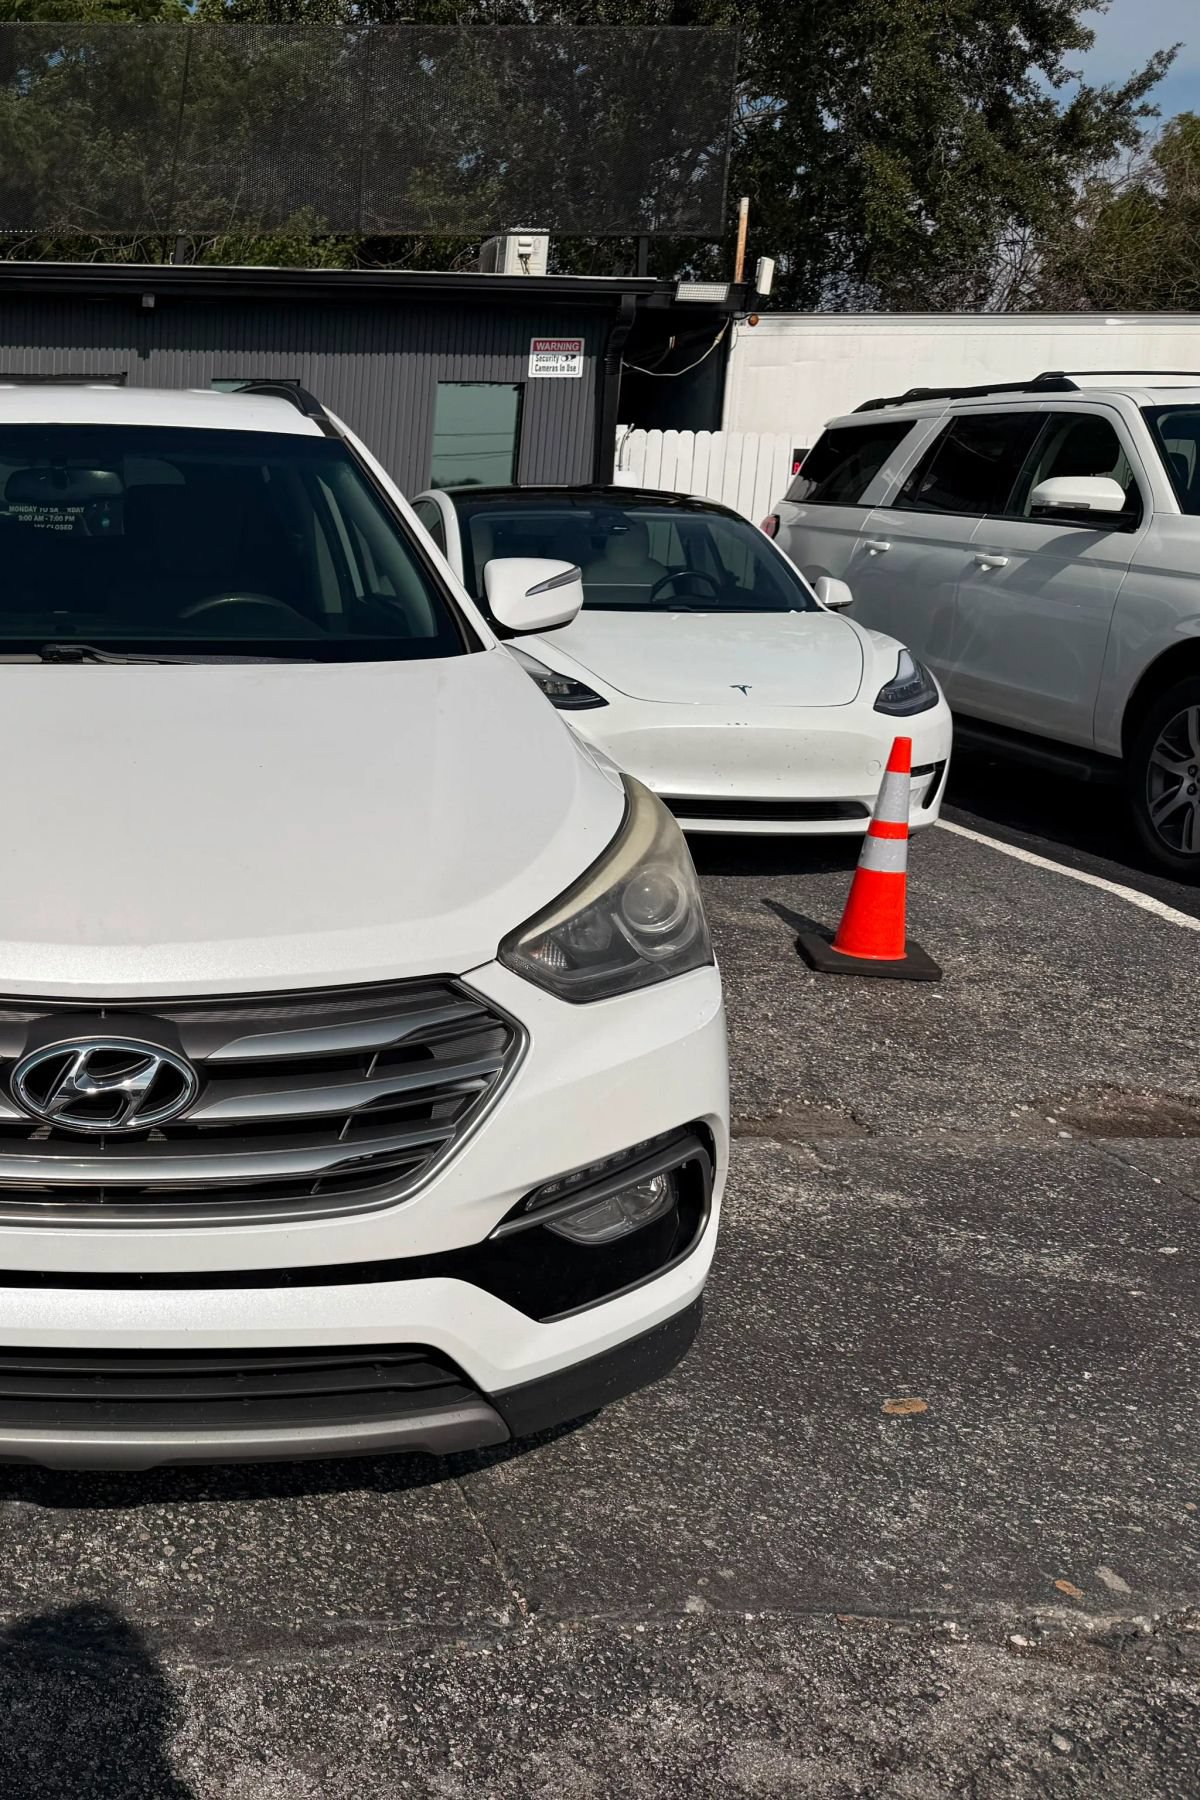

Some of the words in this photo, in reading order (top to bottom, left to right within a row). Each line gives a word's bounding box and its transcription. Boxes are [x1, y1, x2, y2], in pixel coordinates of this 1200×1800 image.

[536, 342, 580, 351] WARNING
[535, 354, 559, 363] Security
[535, 364, 558, 372] Cameras
